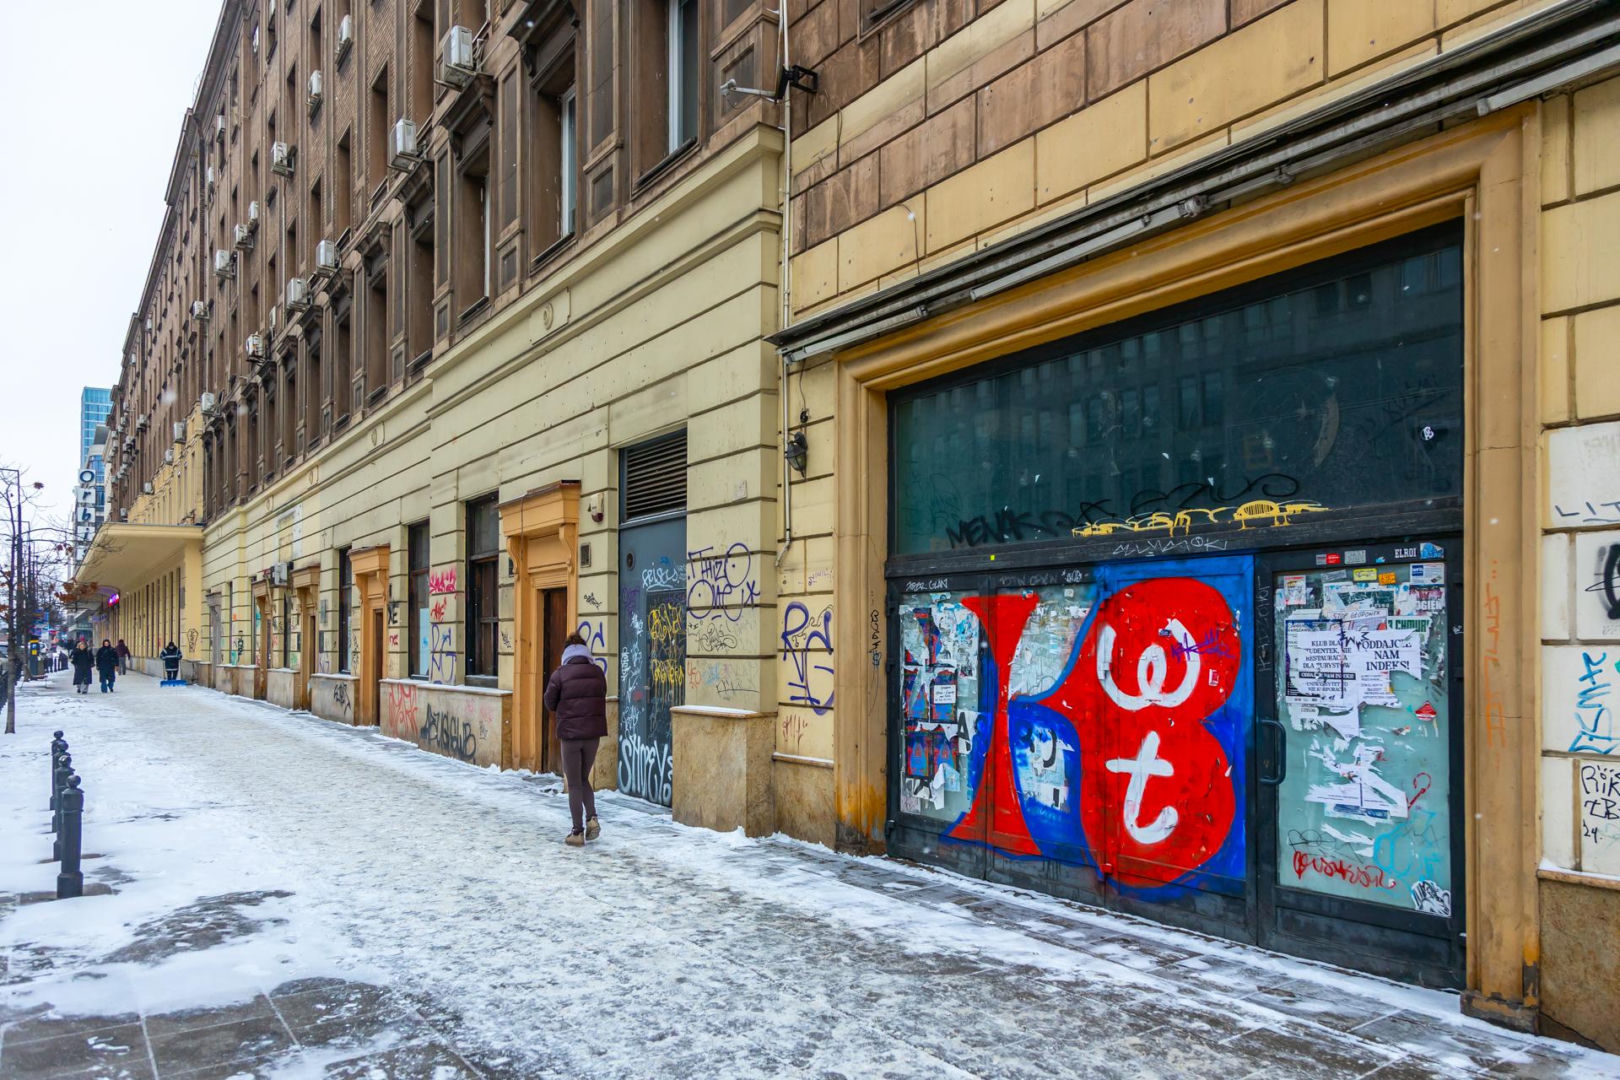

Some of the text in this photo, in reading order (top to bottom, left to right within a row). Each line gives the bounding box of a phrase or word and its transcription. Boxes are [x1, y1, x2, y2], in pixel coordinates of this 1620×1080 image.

[80, 471, 95, 557] Orbi
[1394, 547, 1417, 559] ELROI
[1374, 650, 1400, 660] NAM
